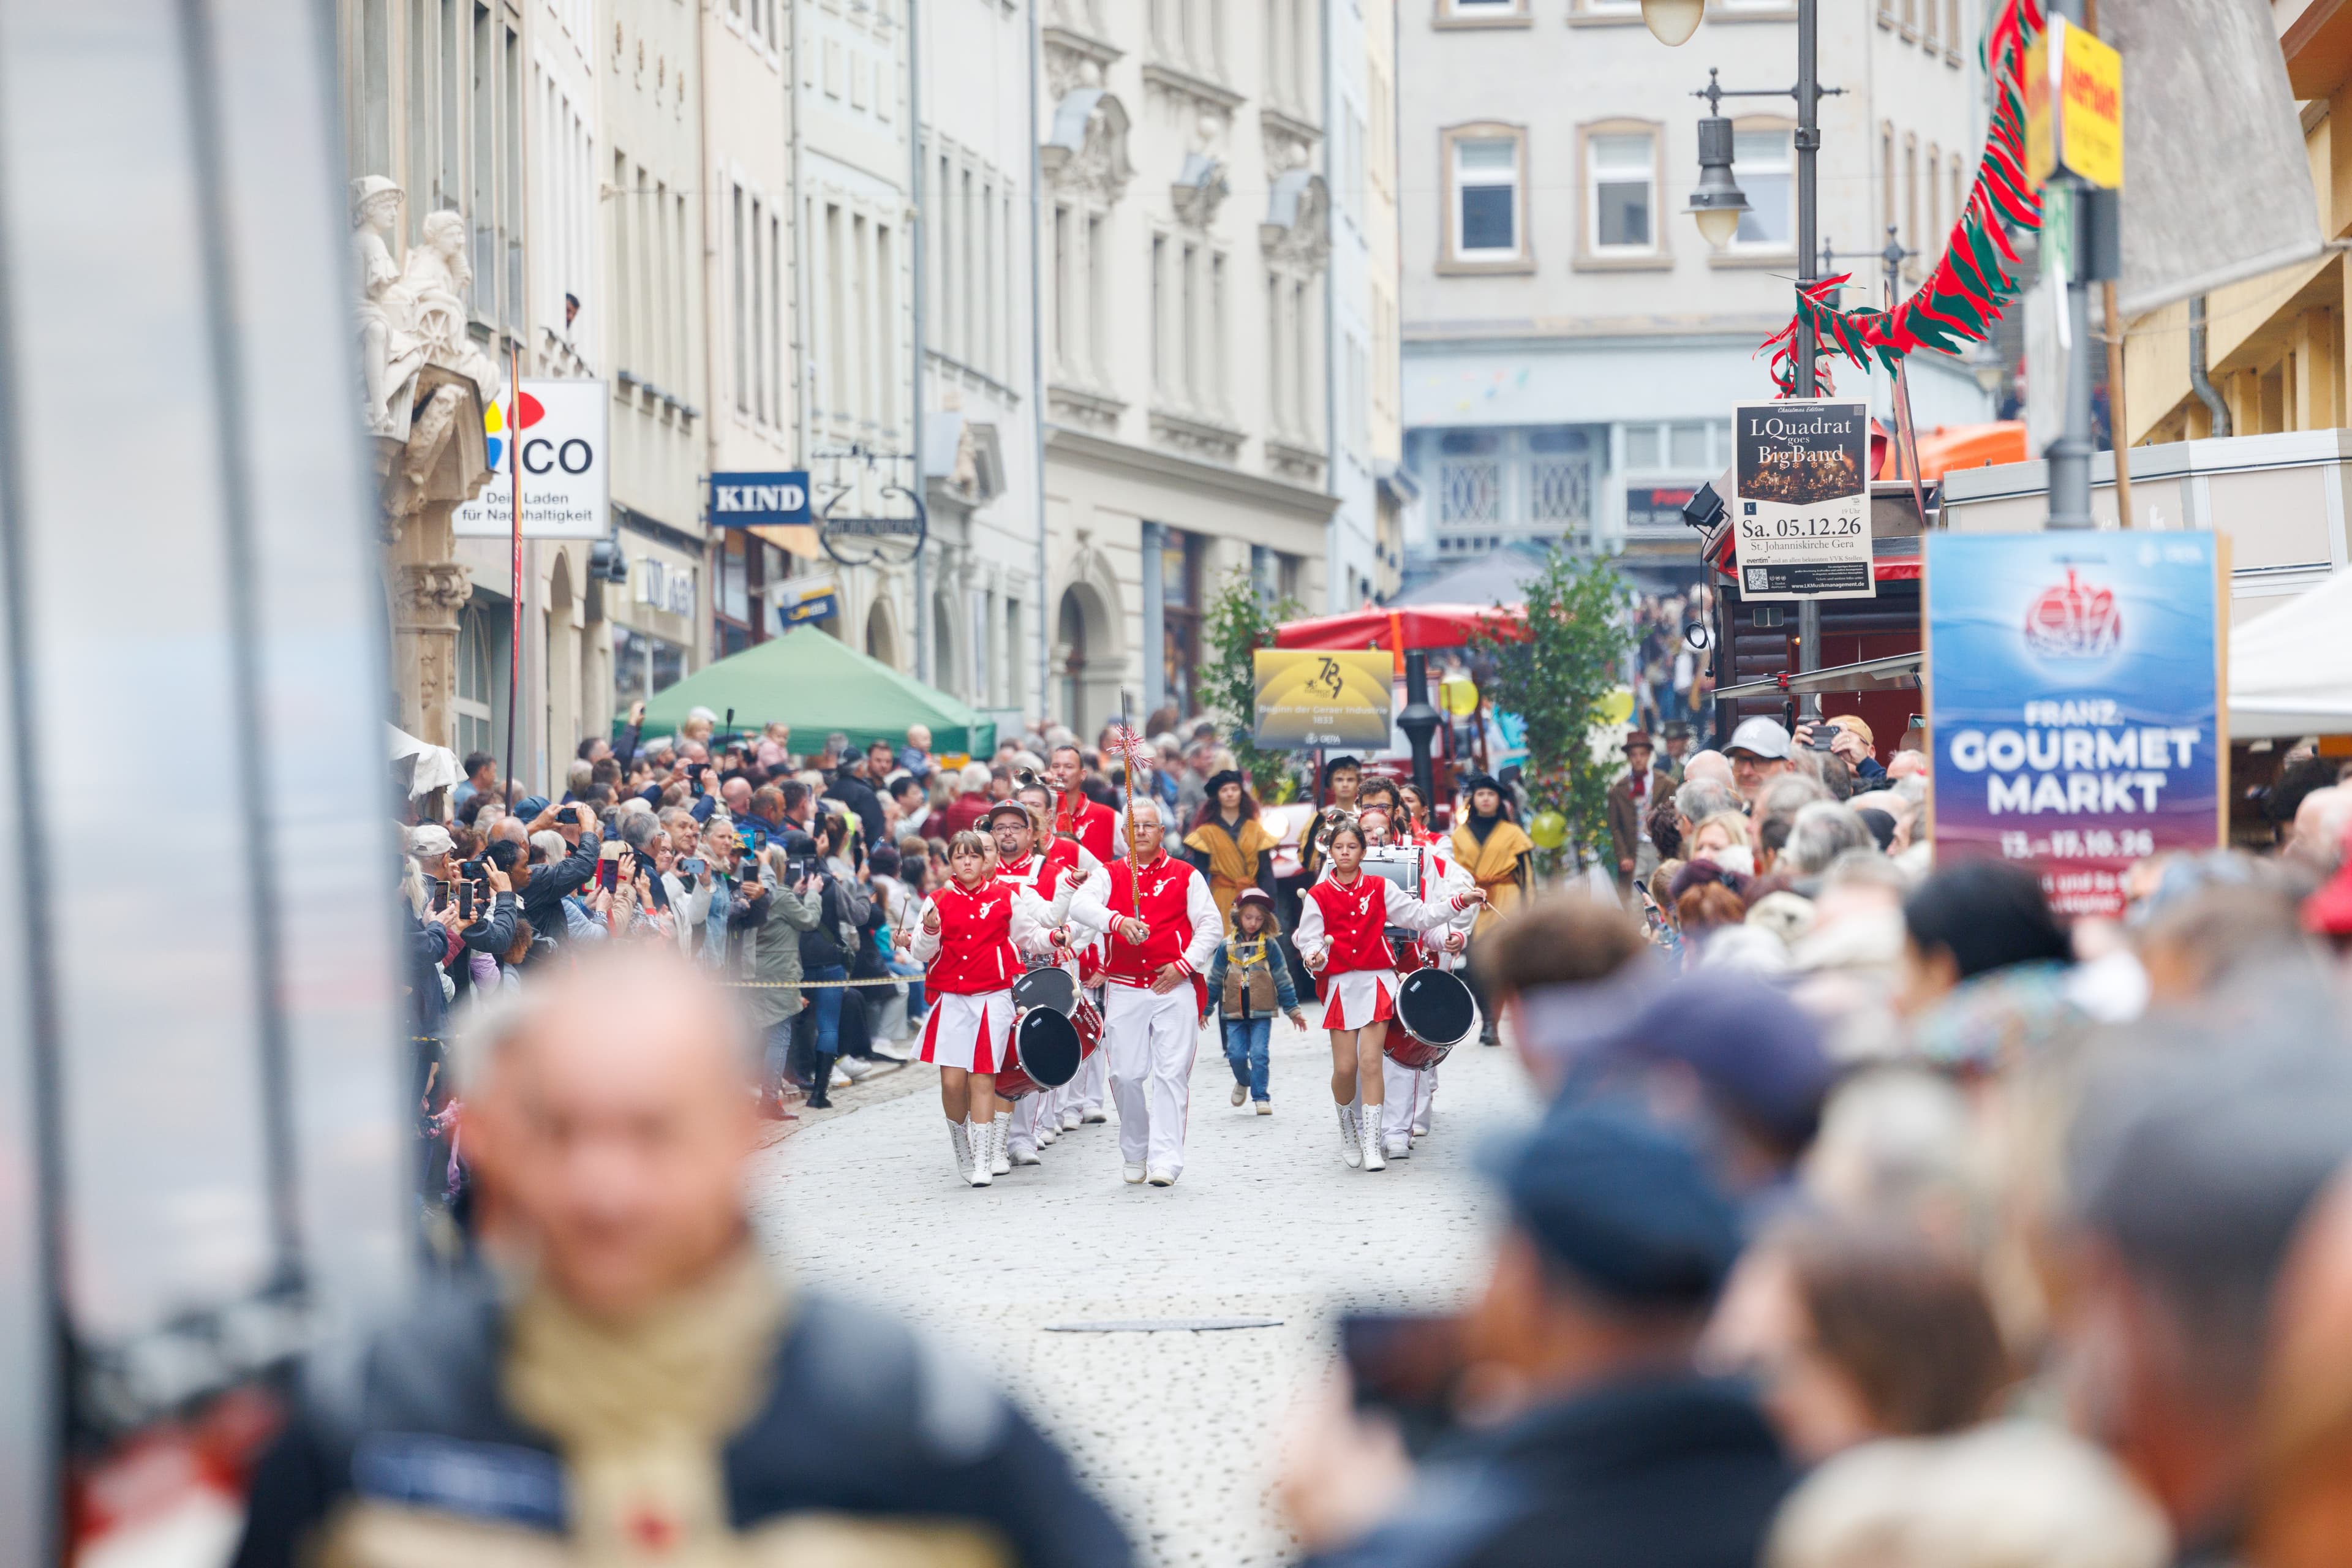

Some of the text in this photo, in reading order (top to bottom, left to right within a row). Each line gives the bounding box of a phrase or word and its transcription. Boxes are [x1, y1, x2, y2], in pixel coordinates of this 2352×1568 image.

[1750, 417, 1852, 440] LQuadrat
[1787, 436, 1810, 446] goes
[1758, 444, 1844, 469] BigBand
[486, 492, 568, 504] Dei Laden
[715, 484, 805, 512] KIND
[462, 509, 593, 524] für Nachaltigkeit
[1743, 517, 1861, 538] Sa. 05.12.26
[1751, 539, 1854, 552] St. Johanniskirche Gera
[1259, 705, 1292, 715] Beginn
[1295, 705, 1310, 714] der
[1346, 706, 1387, 715] Industrie
[2024, 699, 2125, 727] FRANZ.
[1950, 727, 2202, 772] GOURMET
[1987, 771, 2167, 815] MARKT
